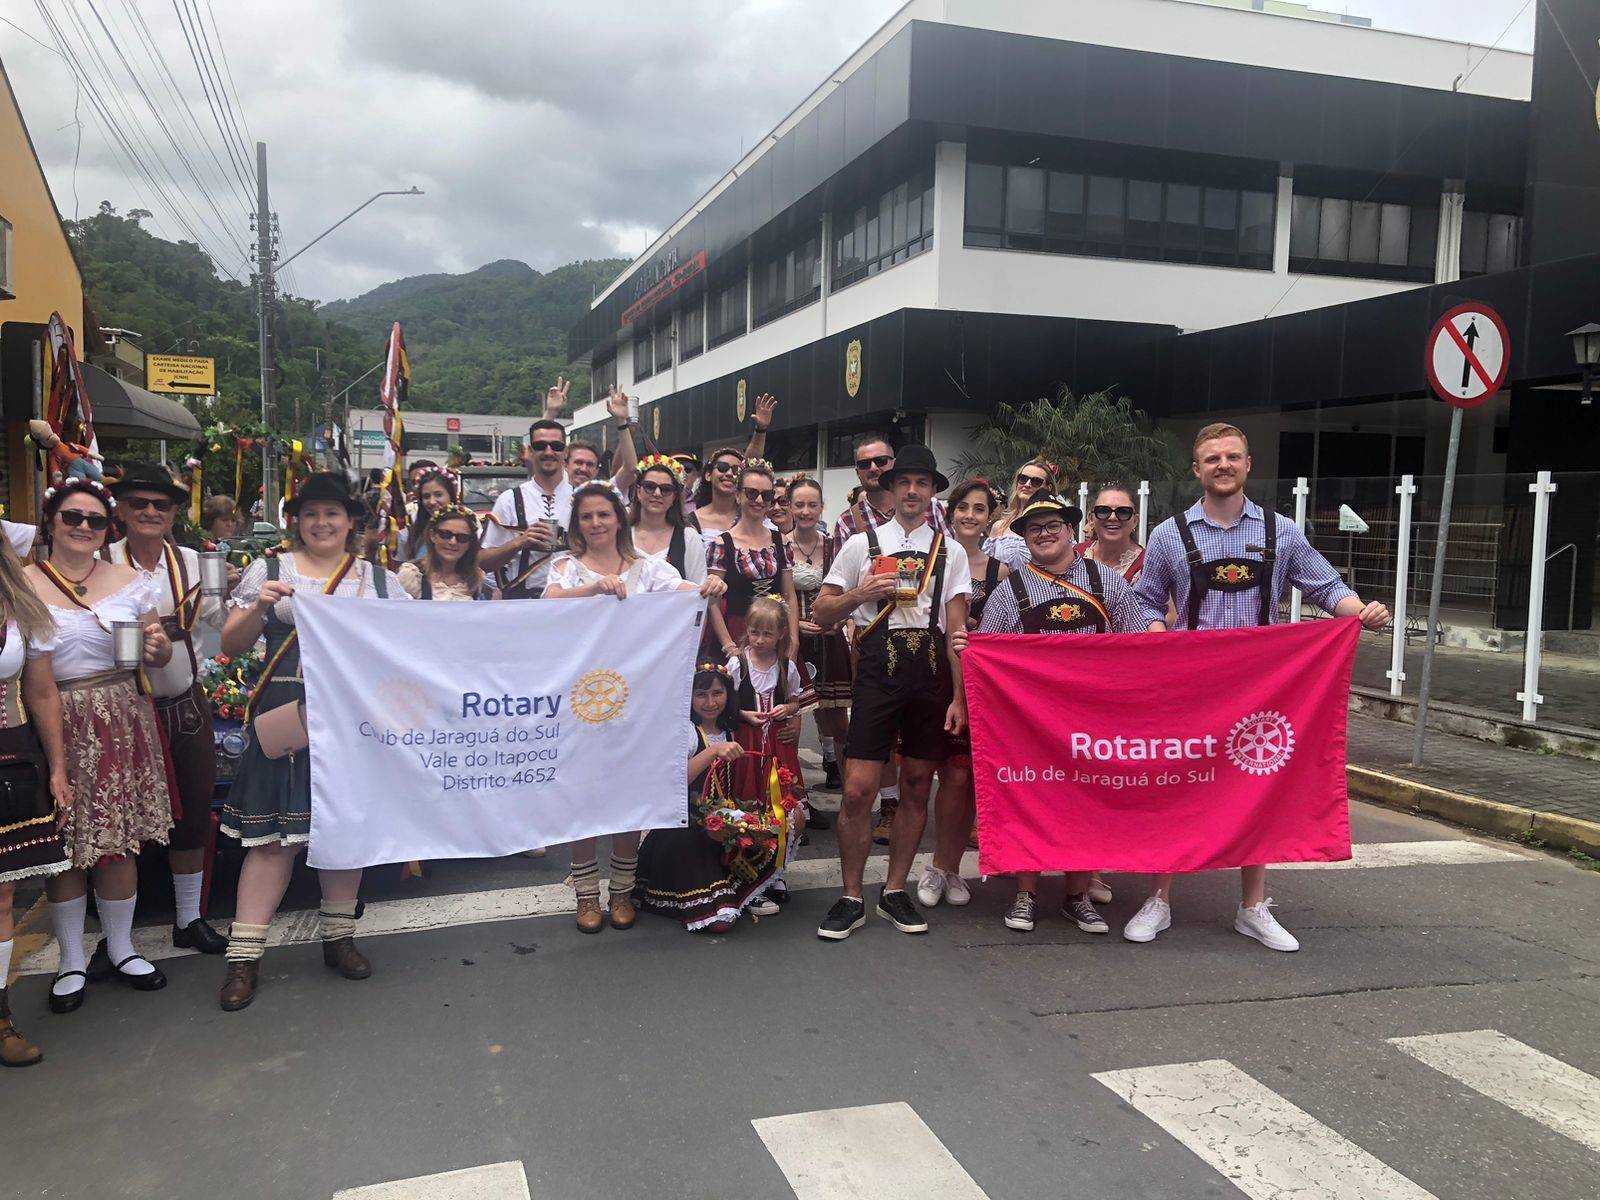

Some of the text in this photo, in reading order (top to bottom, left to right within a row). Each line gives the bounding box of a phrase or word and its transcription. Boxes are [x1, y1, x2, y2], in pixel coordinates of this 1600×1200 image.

[462, 691, 563, 719] Rotary
[402, 728, 425, 746] de
[428, 727, 499, 748] Jaraguá
[506, 725, 529, 743] do
[535, 722, 560, 740] Sul
[1071, 732, 1217, 761] Rotaract
[420, 747, 558, 769] Vale do Itapocu
[442, 766, 557, 791] Distrito 4652
[996, 764, 1216, 791] Club de Jaraguá do Sul
